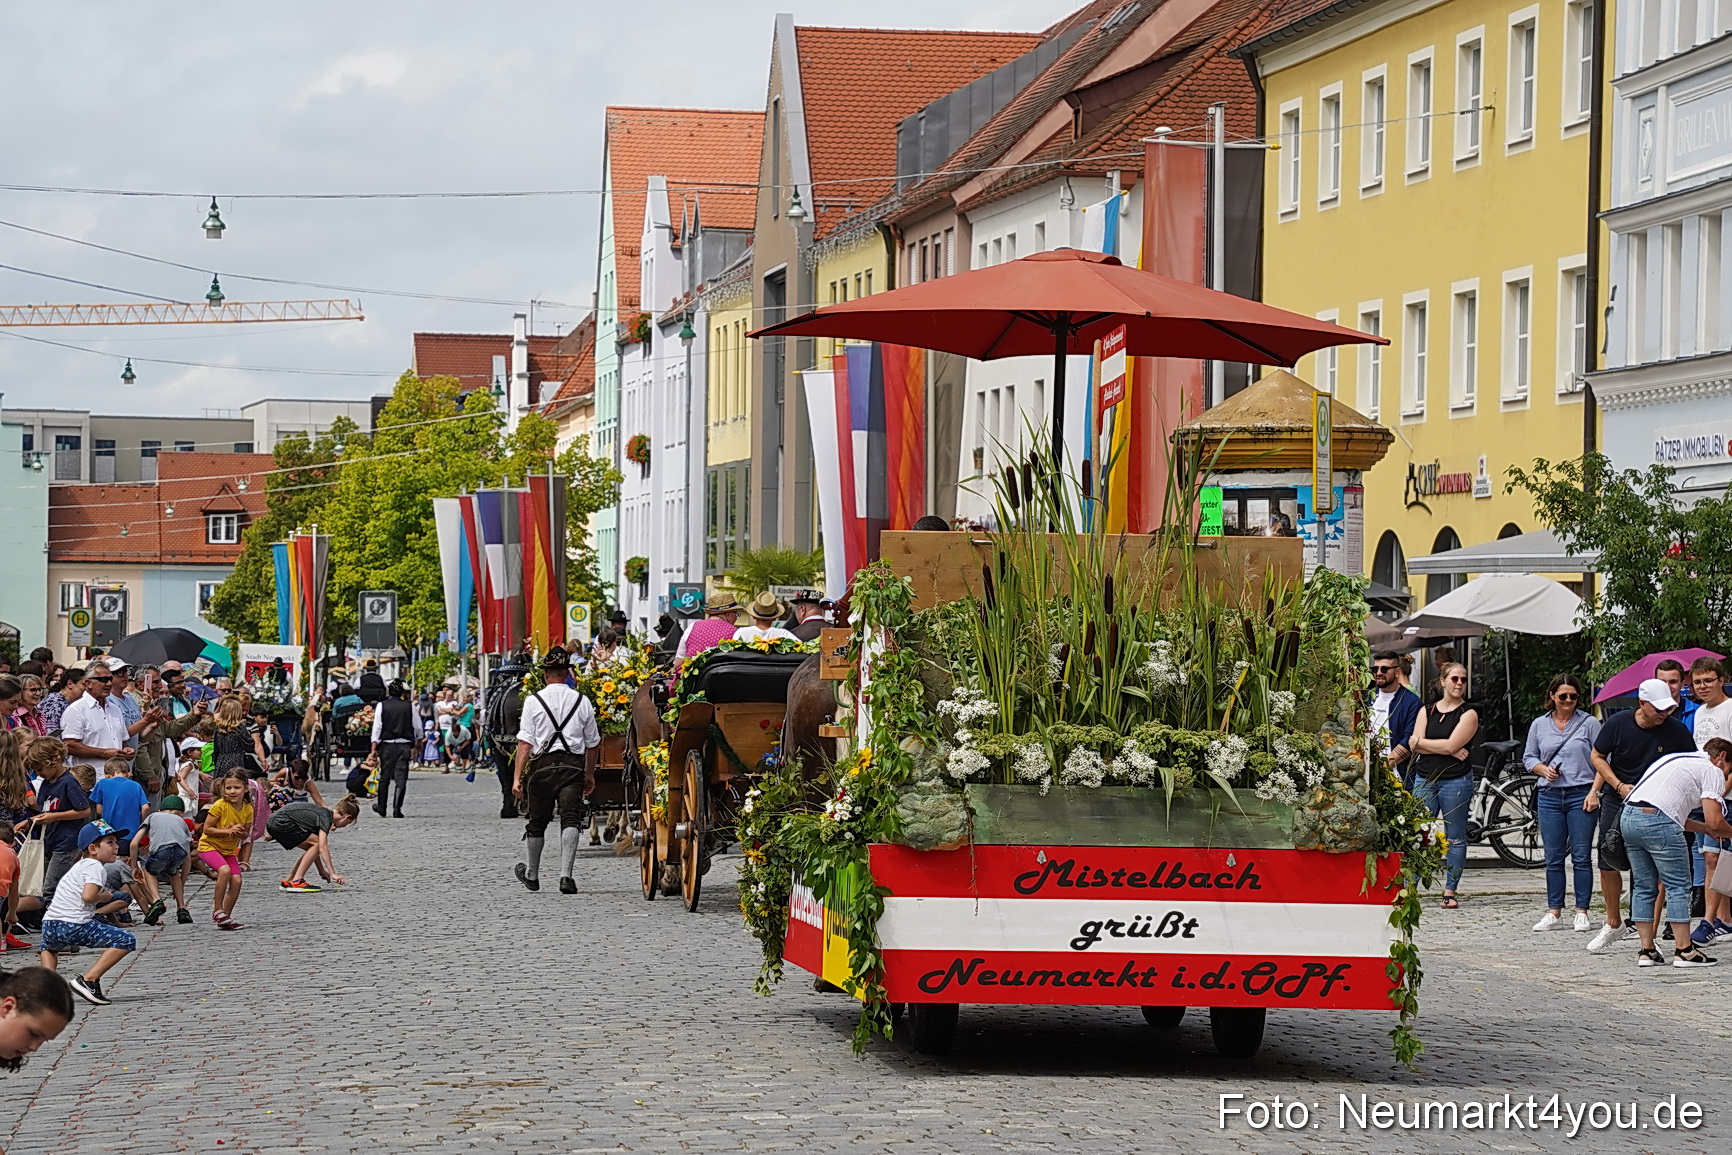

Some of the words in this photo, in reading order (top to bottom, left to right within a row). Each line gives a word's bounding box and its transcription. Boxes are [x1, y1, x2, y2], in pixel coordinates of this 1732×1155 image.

[1677, 104, 1721, 157] BRILLEN
[1683, 434, 1725, 459] IMMOBILIEN
[681, 592, 695, 608] G2
[1014, 859, 1261, 895] Mistelbach
[1070, 910, 1199, 950] grüßt
[917, 958, 1158, 994] Neumarkt
